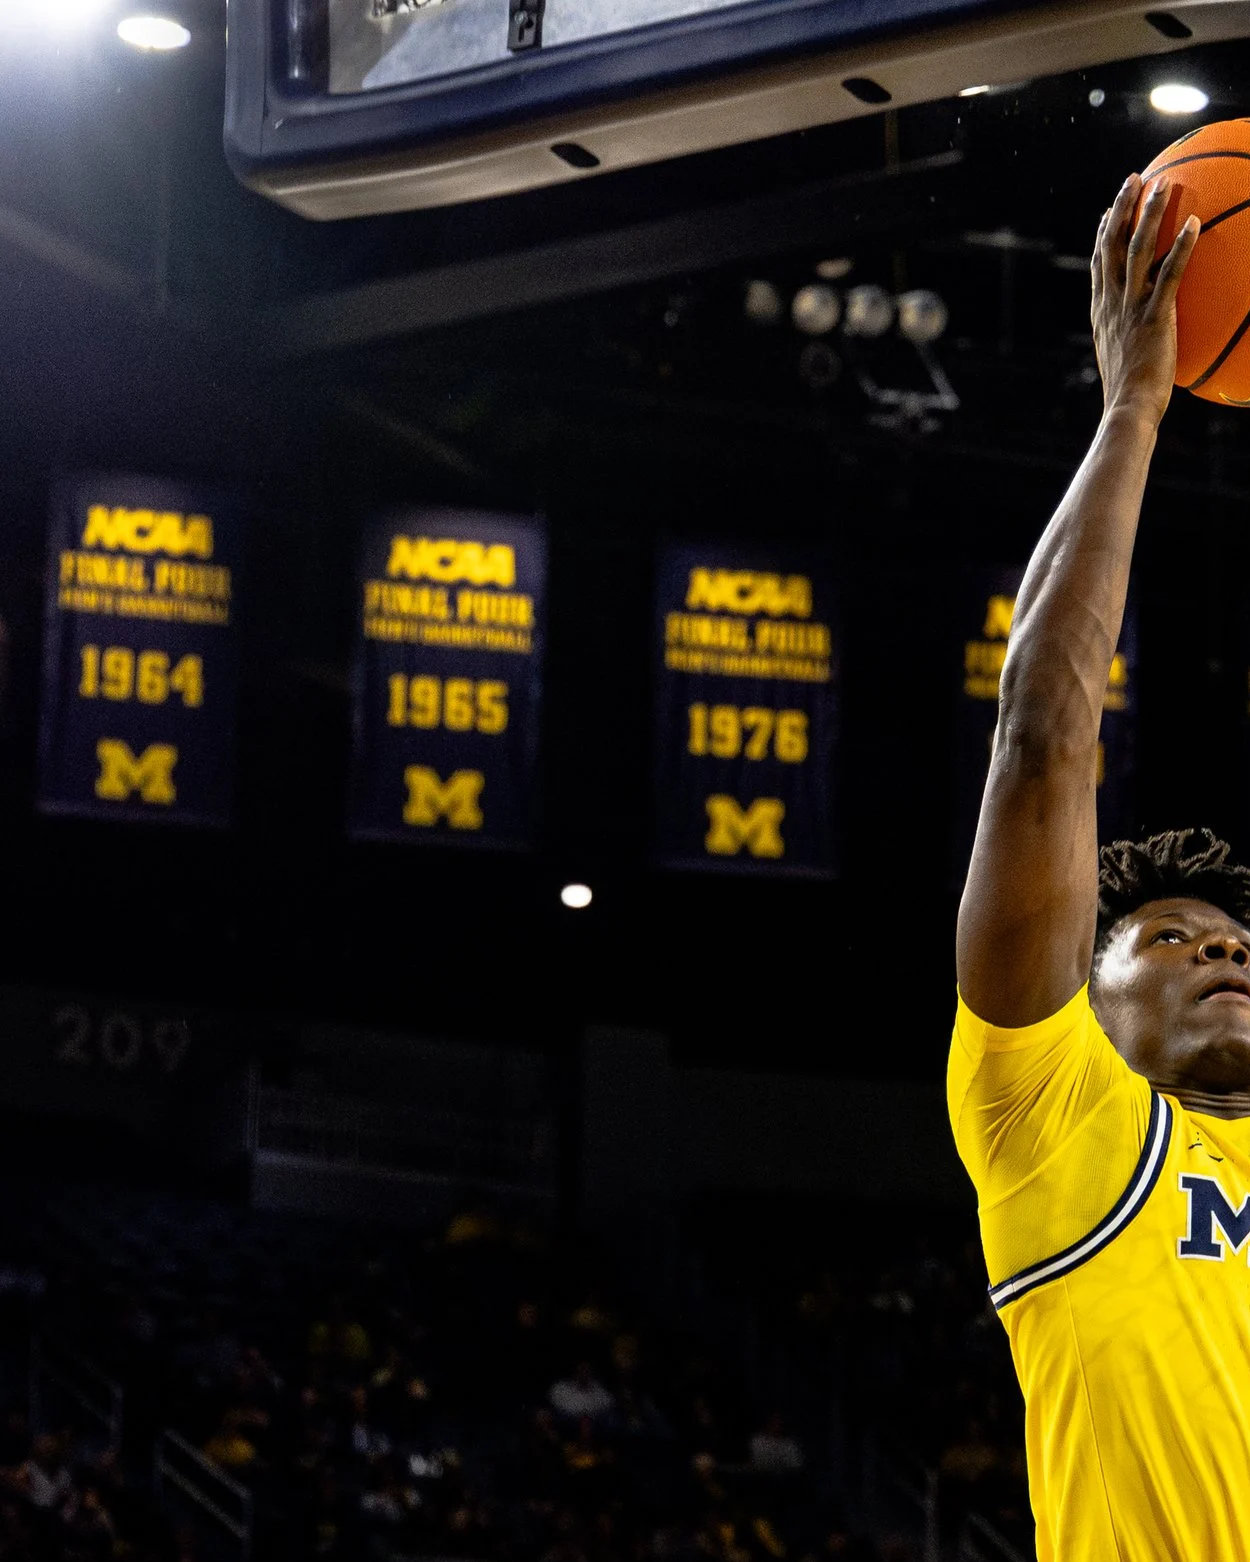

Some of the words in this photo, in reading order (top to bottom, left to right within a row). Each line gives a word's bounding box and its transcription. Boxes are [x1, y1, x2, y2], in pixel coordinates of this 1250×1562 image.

[83, 505, 213, 558] NCAA
[387, 534, 516, 587] NCAA
[59, 550, 147, 592] FINAL
[363, 580, 449, 620] FINAL
[685, 566, 814, 618] NCAA
[78, 643, 205, 708] 1964
[387, 671, 509, 735] 1965
[687, 701, 810, 763] 1976
[94, 737, 179, 806] M
[403, 763, 486, 831] M
[704, 793, 786, 859] M
[50, 1004, 191, 1071] 209
